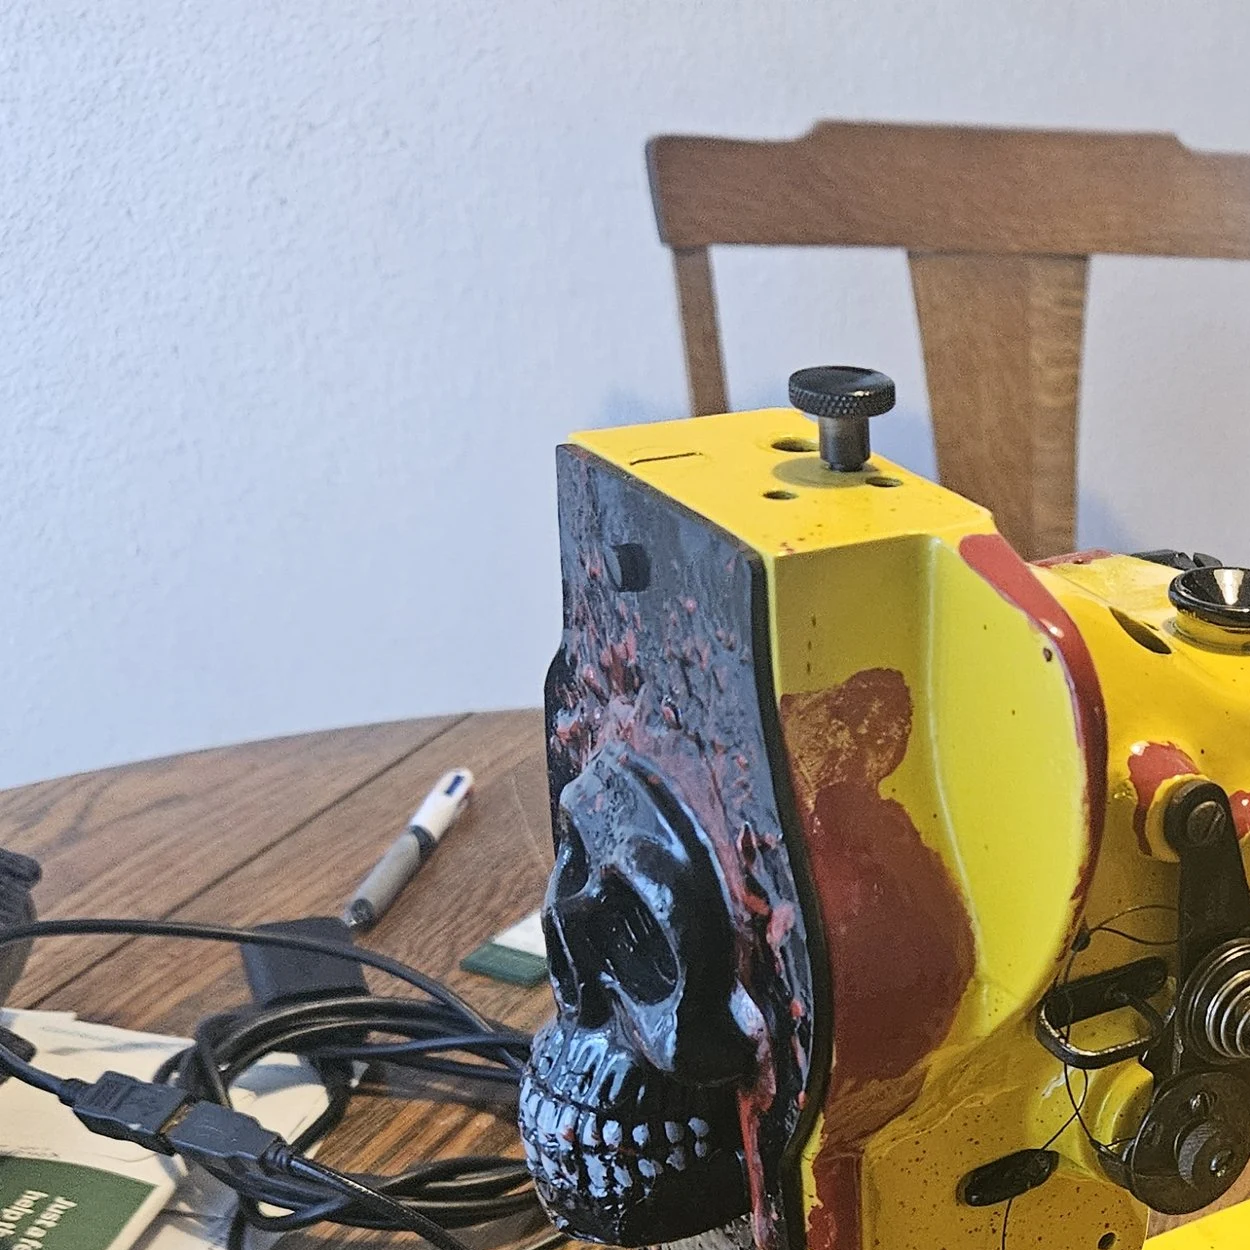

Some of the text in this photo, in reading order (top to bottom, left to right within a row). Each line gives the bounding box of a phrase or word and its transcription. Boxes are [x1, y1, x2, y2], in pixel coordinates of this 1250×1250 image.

[0, 1190, 49, 1222] help
[34, 1196, 78, 1229] Just
[24, 1226, 47, 1238] a
